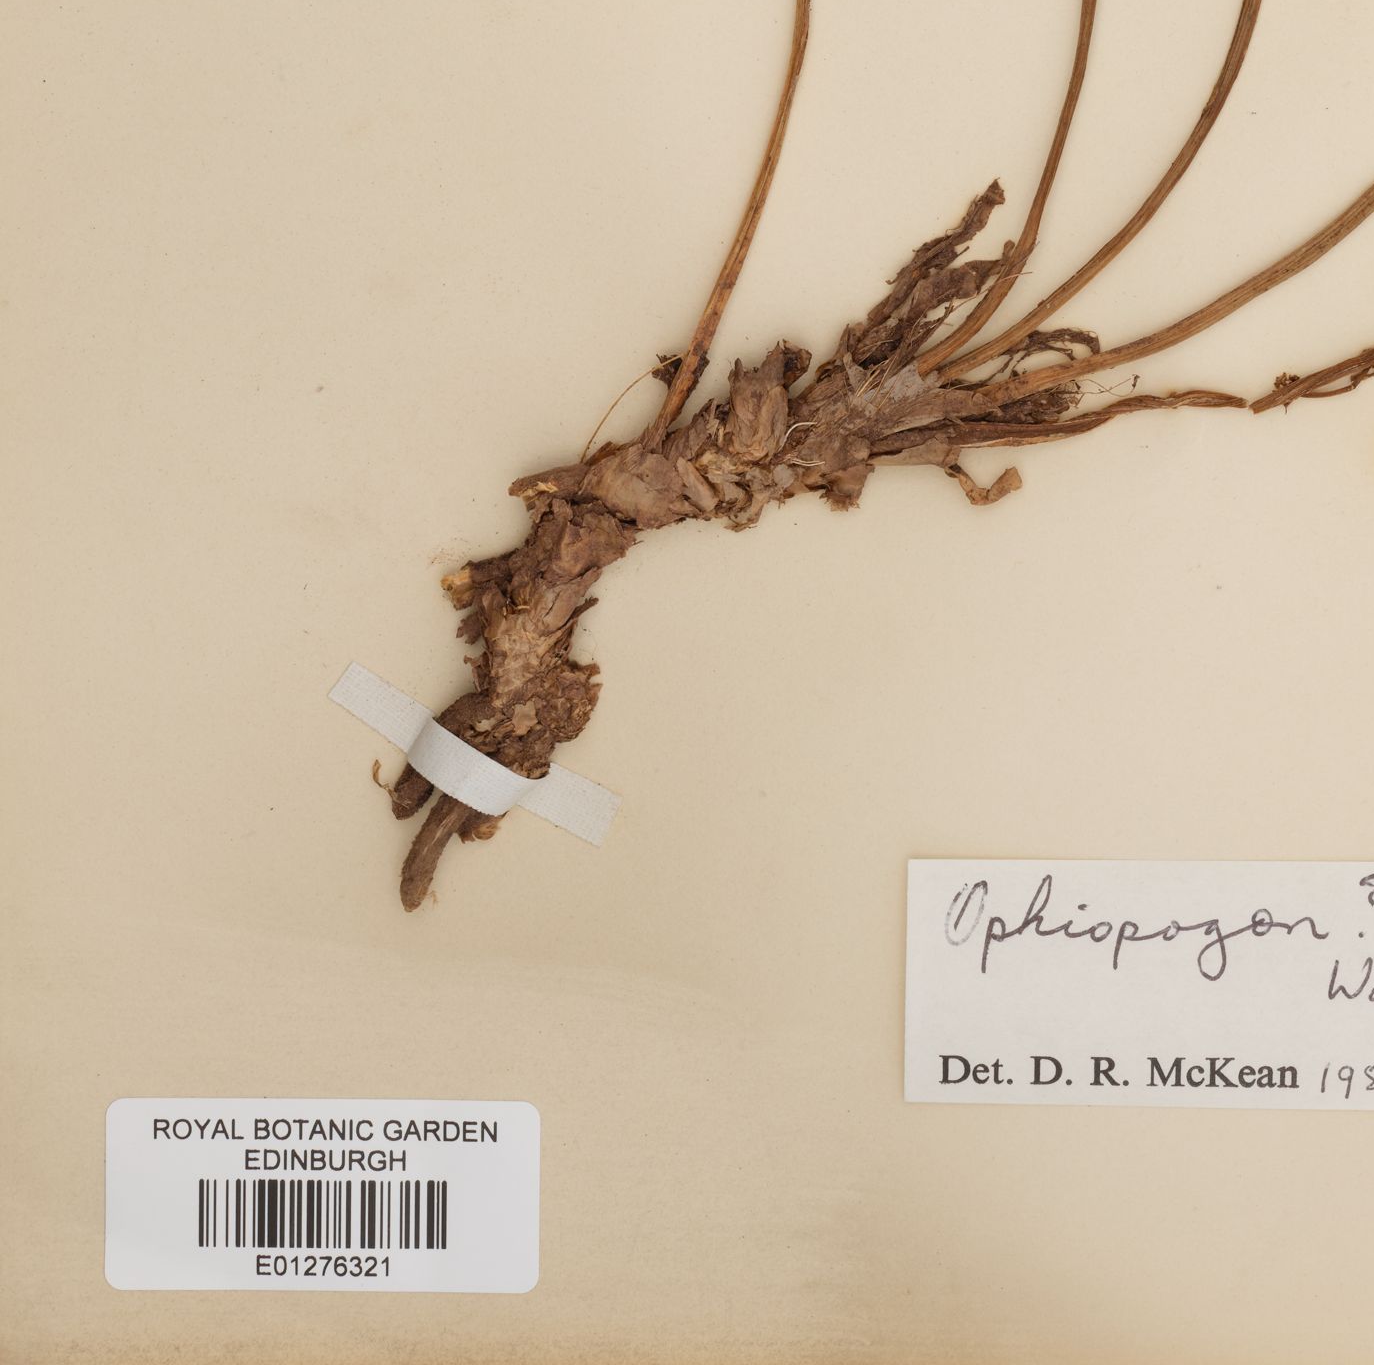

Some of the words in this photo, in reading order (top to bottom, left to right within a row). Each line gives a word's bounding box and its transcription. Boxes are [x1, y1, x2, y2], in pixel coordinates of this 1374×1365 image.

[945, 875, 1330, 981] Ophiopogon
[939, 1055, 1014, 1088] Det.
[1029, 1055, 1074, 1087] D.
[1091, 1057, 1129, 1088] R.
[1146, 1055, 1299, 1090] McKean
[153, 1118, 245, 1140] ROYAL
[254, 1118, 374, 1142] BOTANIC
[383, 1119, 498, 1143] GARDEN
[244, 1148, 407, 1172] EDINBURGH
[256, 1254, 390, 1278] E01276321
